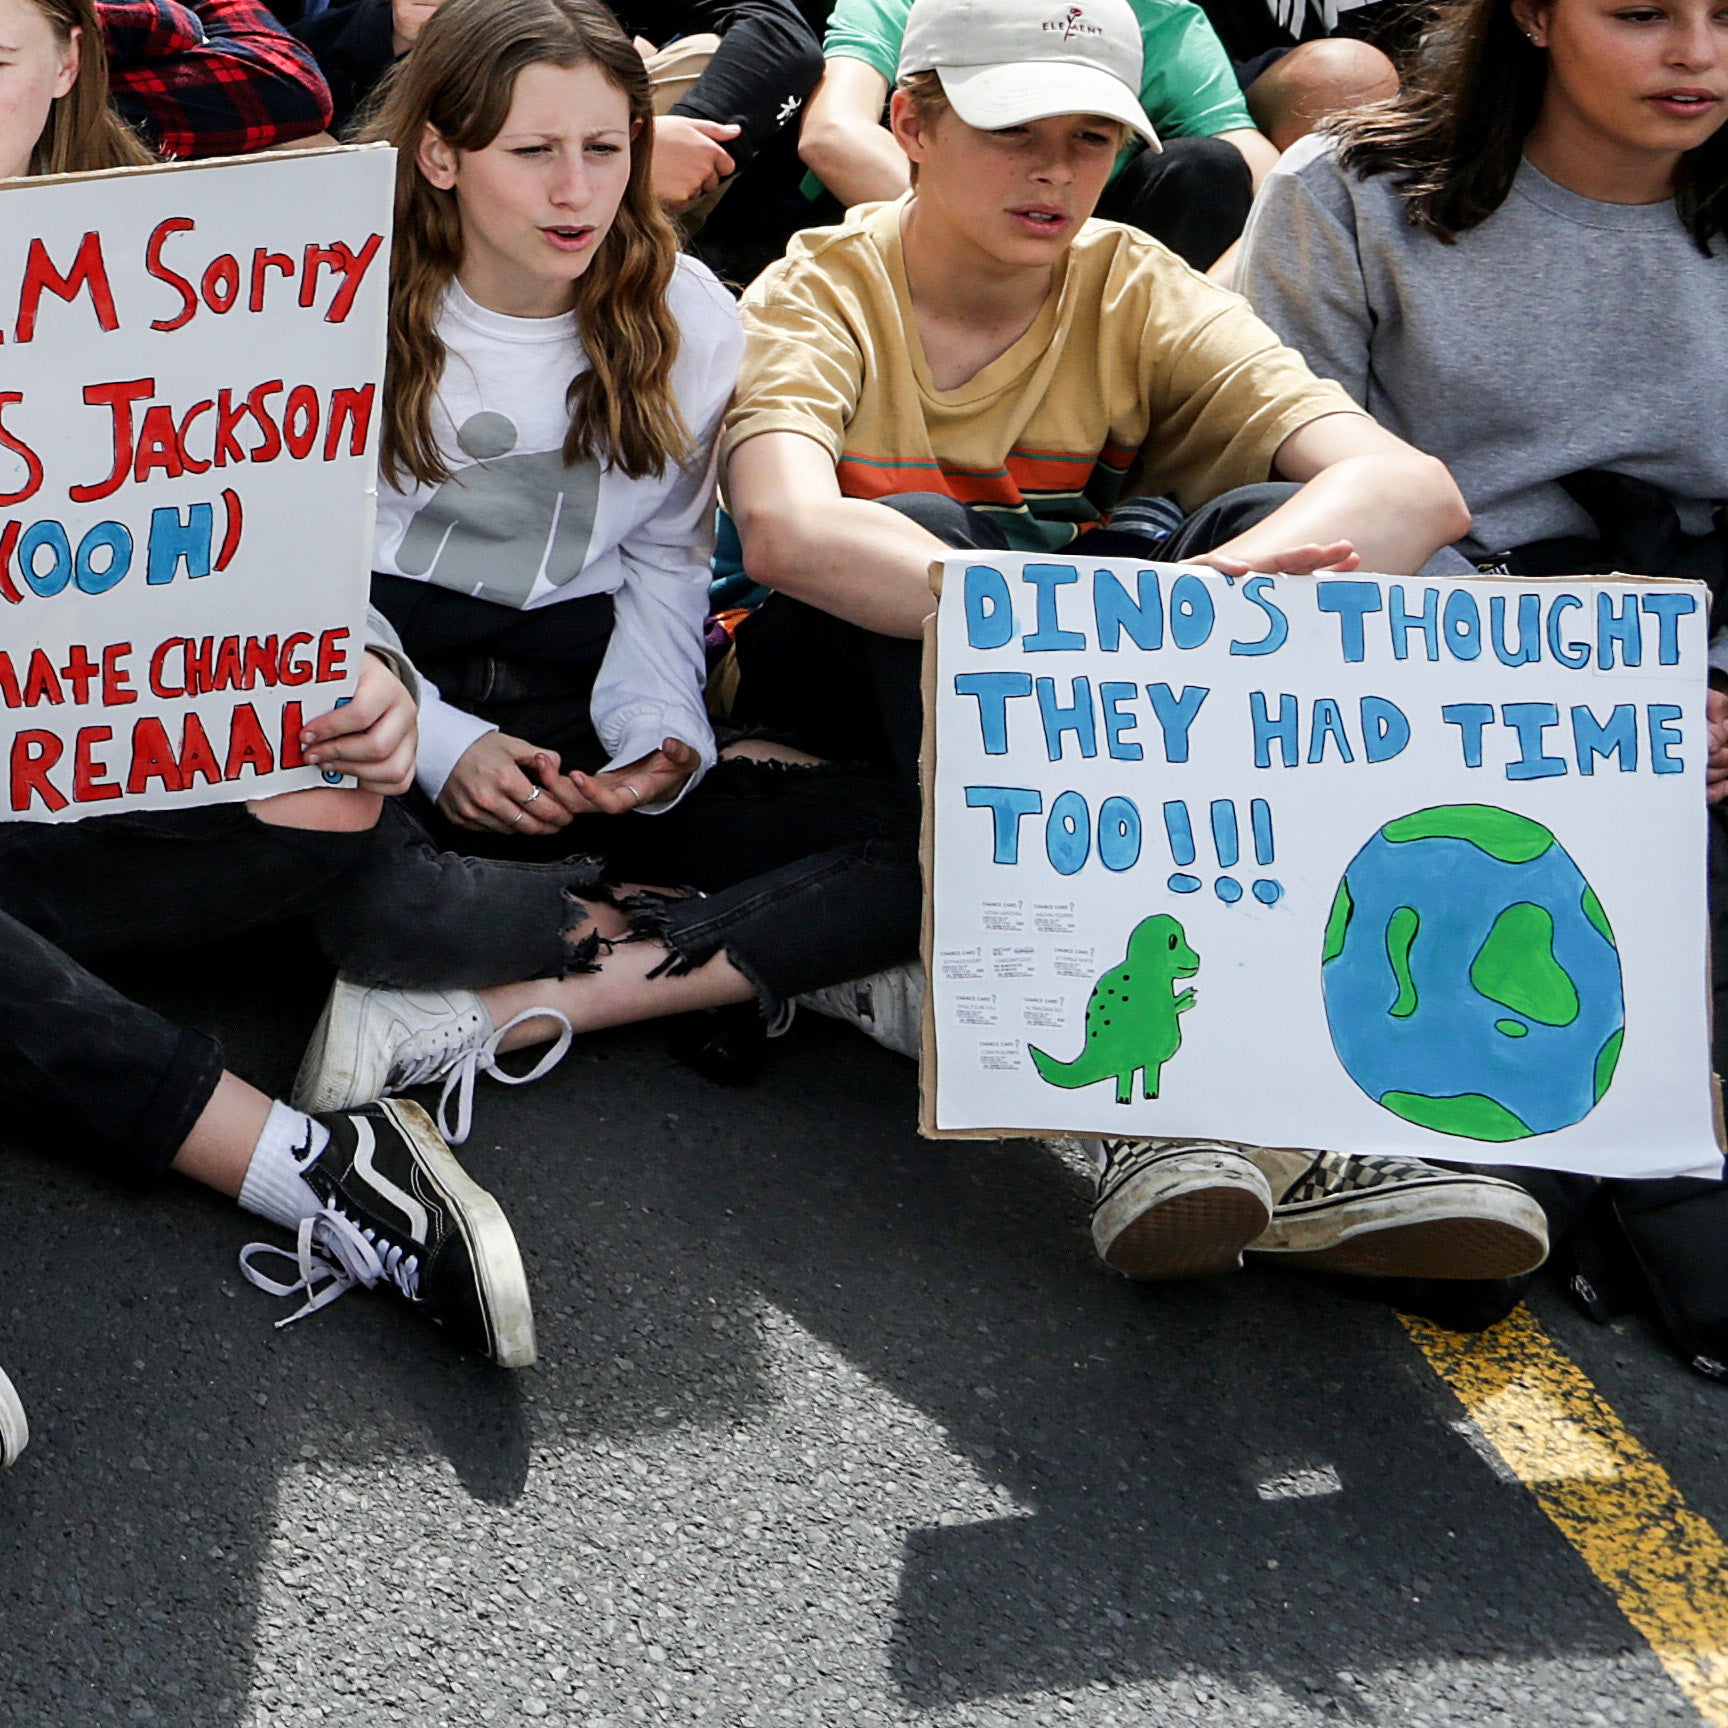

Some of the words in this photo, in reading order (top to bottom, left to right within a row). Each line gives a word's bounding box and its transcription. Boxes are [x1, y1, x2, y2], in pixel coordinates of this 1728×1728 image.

[1042, 20, 1104, 38] ELEMENT
[145, 216, 384, 333] Sorry
[69, 377, 376, 504] JACKSON
[148, 626, 351, 700] CHANGE
[962, 562, 1289, 657] DINO'S
[1315, 579, 1697, 671] THOUGHT
[953, 671, 1211, 764] THEY
[1249, 690, 1412, 769] HAD
[1441, 702, 1685, 781] TIME
[962, 784, 1285, 906] TOO!!!
